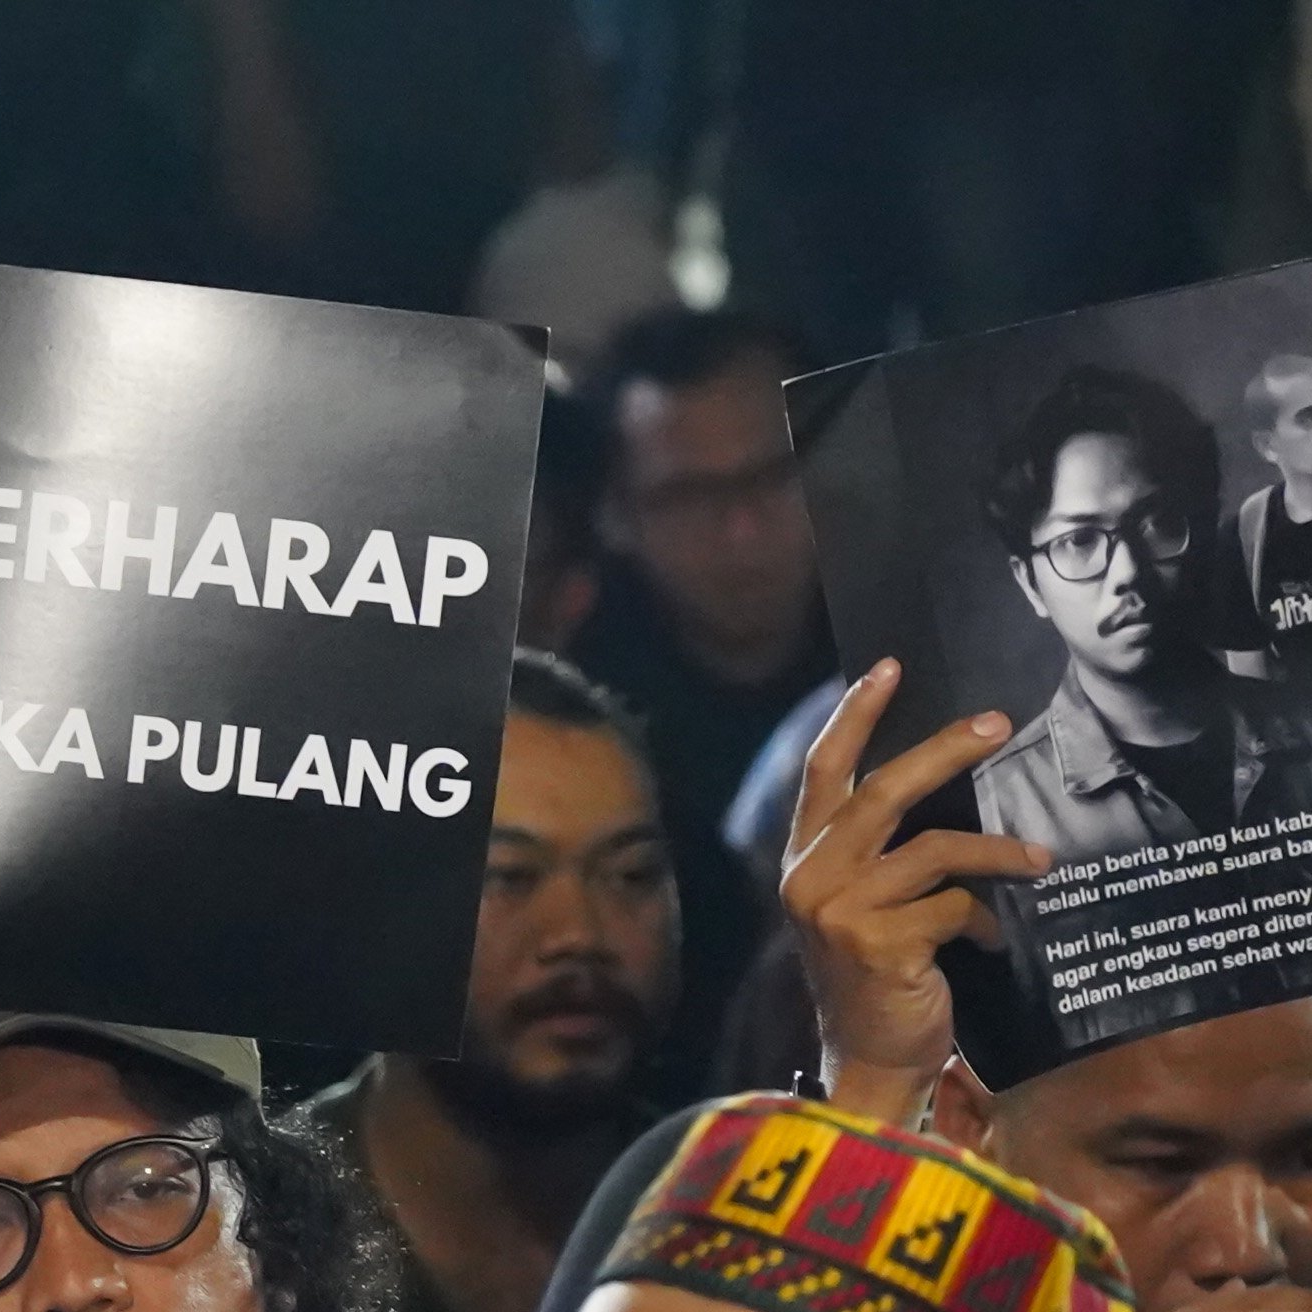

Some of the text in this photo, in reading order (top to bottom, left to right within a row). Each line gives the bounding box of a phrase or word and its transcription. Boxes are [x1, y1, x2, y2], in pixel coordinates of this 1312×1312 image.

[127, 714, 472, 819] PULANG
[1036, 886, 1101, 915] selalu
[1103, 860, 1219, 899] membawa
[1222, 846, 1284, 872] suara
[1104, 846, 1170, 873] berita
[1172, 833, 1228, 862] yang
[1230, 823, 1271, 845] kau
[1045, 933, 1091, 963] Hari
[1092, 926, 1128, 950] ini,
[1130, 914, 1191, 940] suara
[1194, 896, 1248, 926] kami
[1052, 962, 1099, 989] agar
[1103, 941, 1183, 973] engkau
[1186, 923, 1261, 953] segera
[1057, 982, 1123, 1015] dalam
[1125, 959, 1218, 994] keadaan
[1221, 941, 1283, 970] sehat
